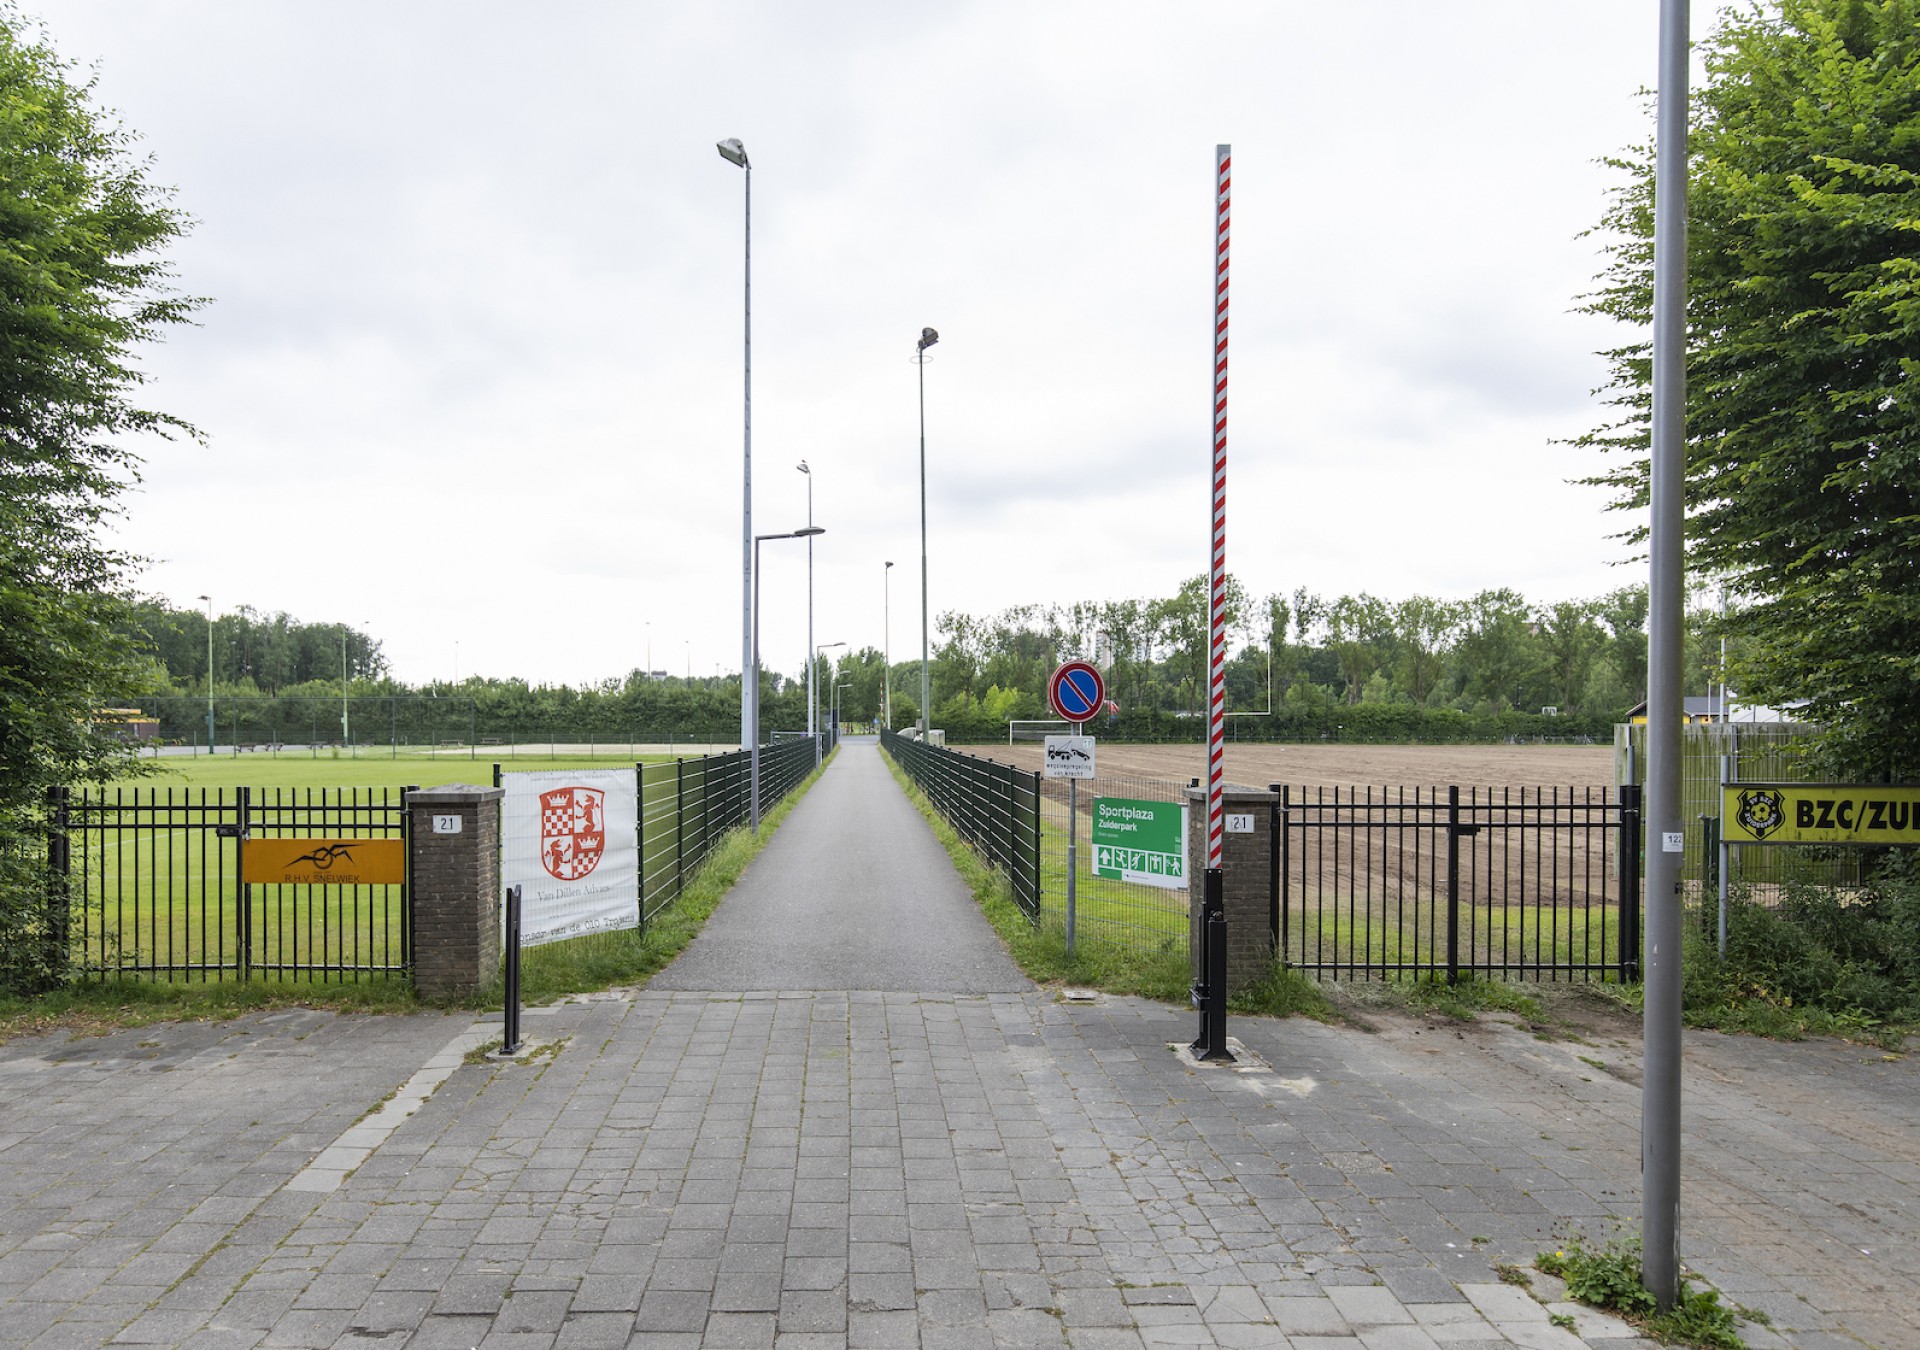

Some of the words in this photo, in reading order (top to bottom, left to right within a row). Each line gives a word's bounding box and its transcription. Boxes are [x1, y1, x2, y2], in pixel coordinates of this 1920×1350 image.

[1098, 803, 1154, 820] Sportplaza
[441, 817, 453, 830] 21
[1098, 818, 1138, 832] Zuiderpark
[1233, 816, 1246, 829] 21
[313, 874, 360, 883] SNELWIEK
[537, 891, 554, 901] Van
[556, 887, 582, 899] Dillen
[583, 884, 610, 896] Advies
[520, 930, 547, 942] onsor
[569, 922, 581, 932] de
